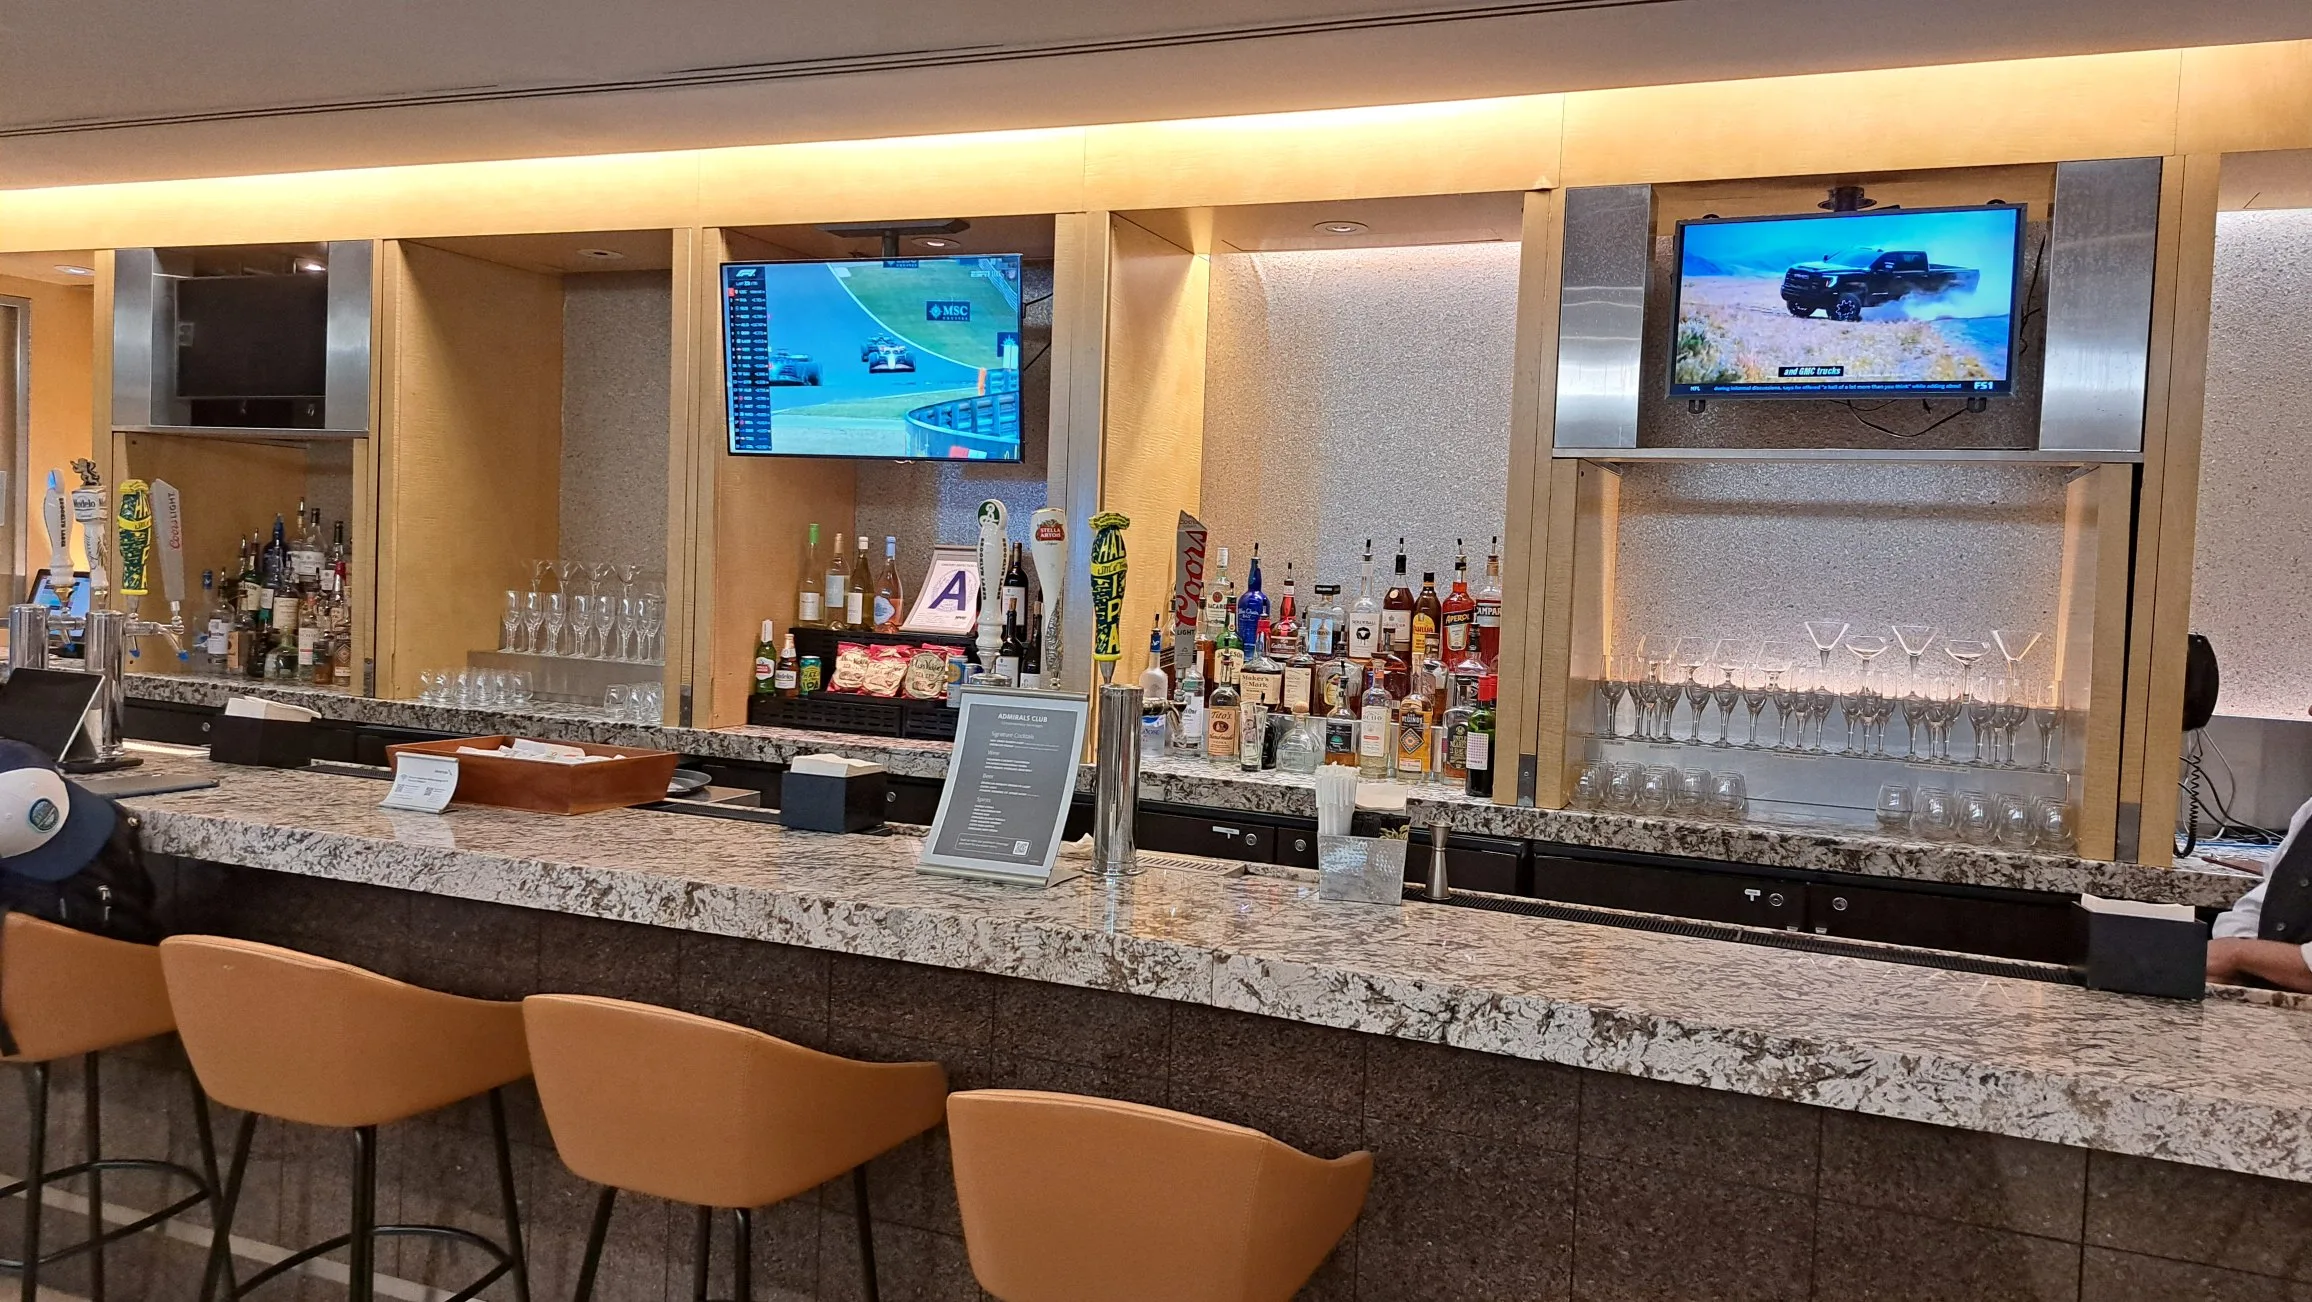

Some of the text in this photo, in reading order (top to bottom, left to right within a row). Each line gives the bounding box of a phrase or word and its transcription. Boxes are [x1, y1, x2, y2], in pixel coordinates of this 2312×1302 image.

[943, 306, 968, 316] MSC
[1784, 367, 1841, 376] and GMC trucks
[168, 493, 177, 518] LIGHT
[1175, 530, 1208, 628] Coors
[928, 571, 966, 611] A
[1446, 614, 1470, 623] APEROL
[998, 713, 1030, 722] ADMIRALS
[1211, 711, 1231, 719] Tito's
